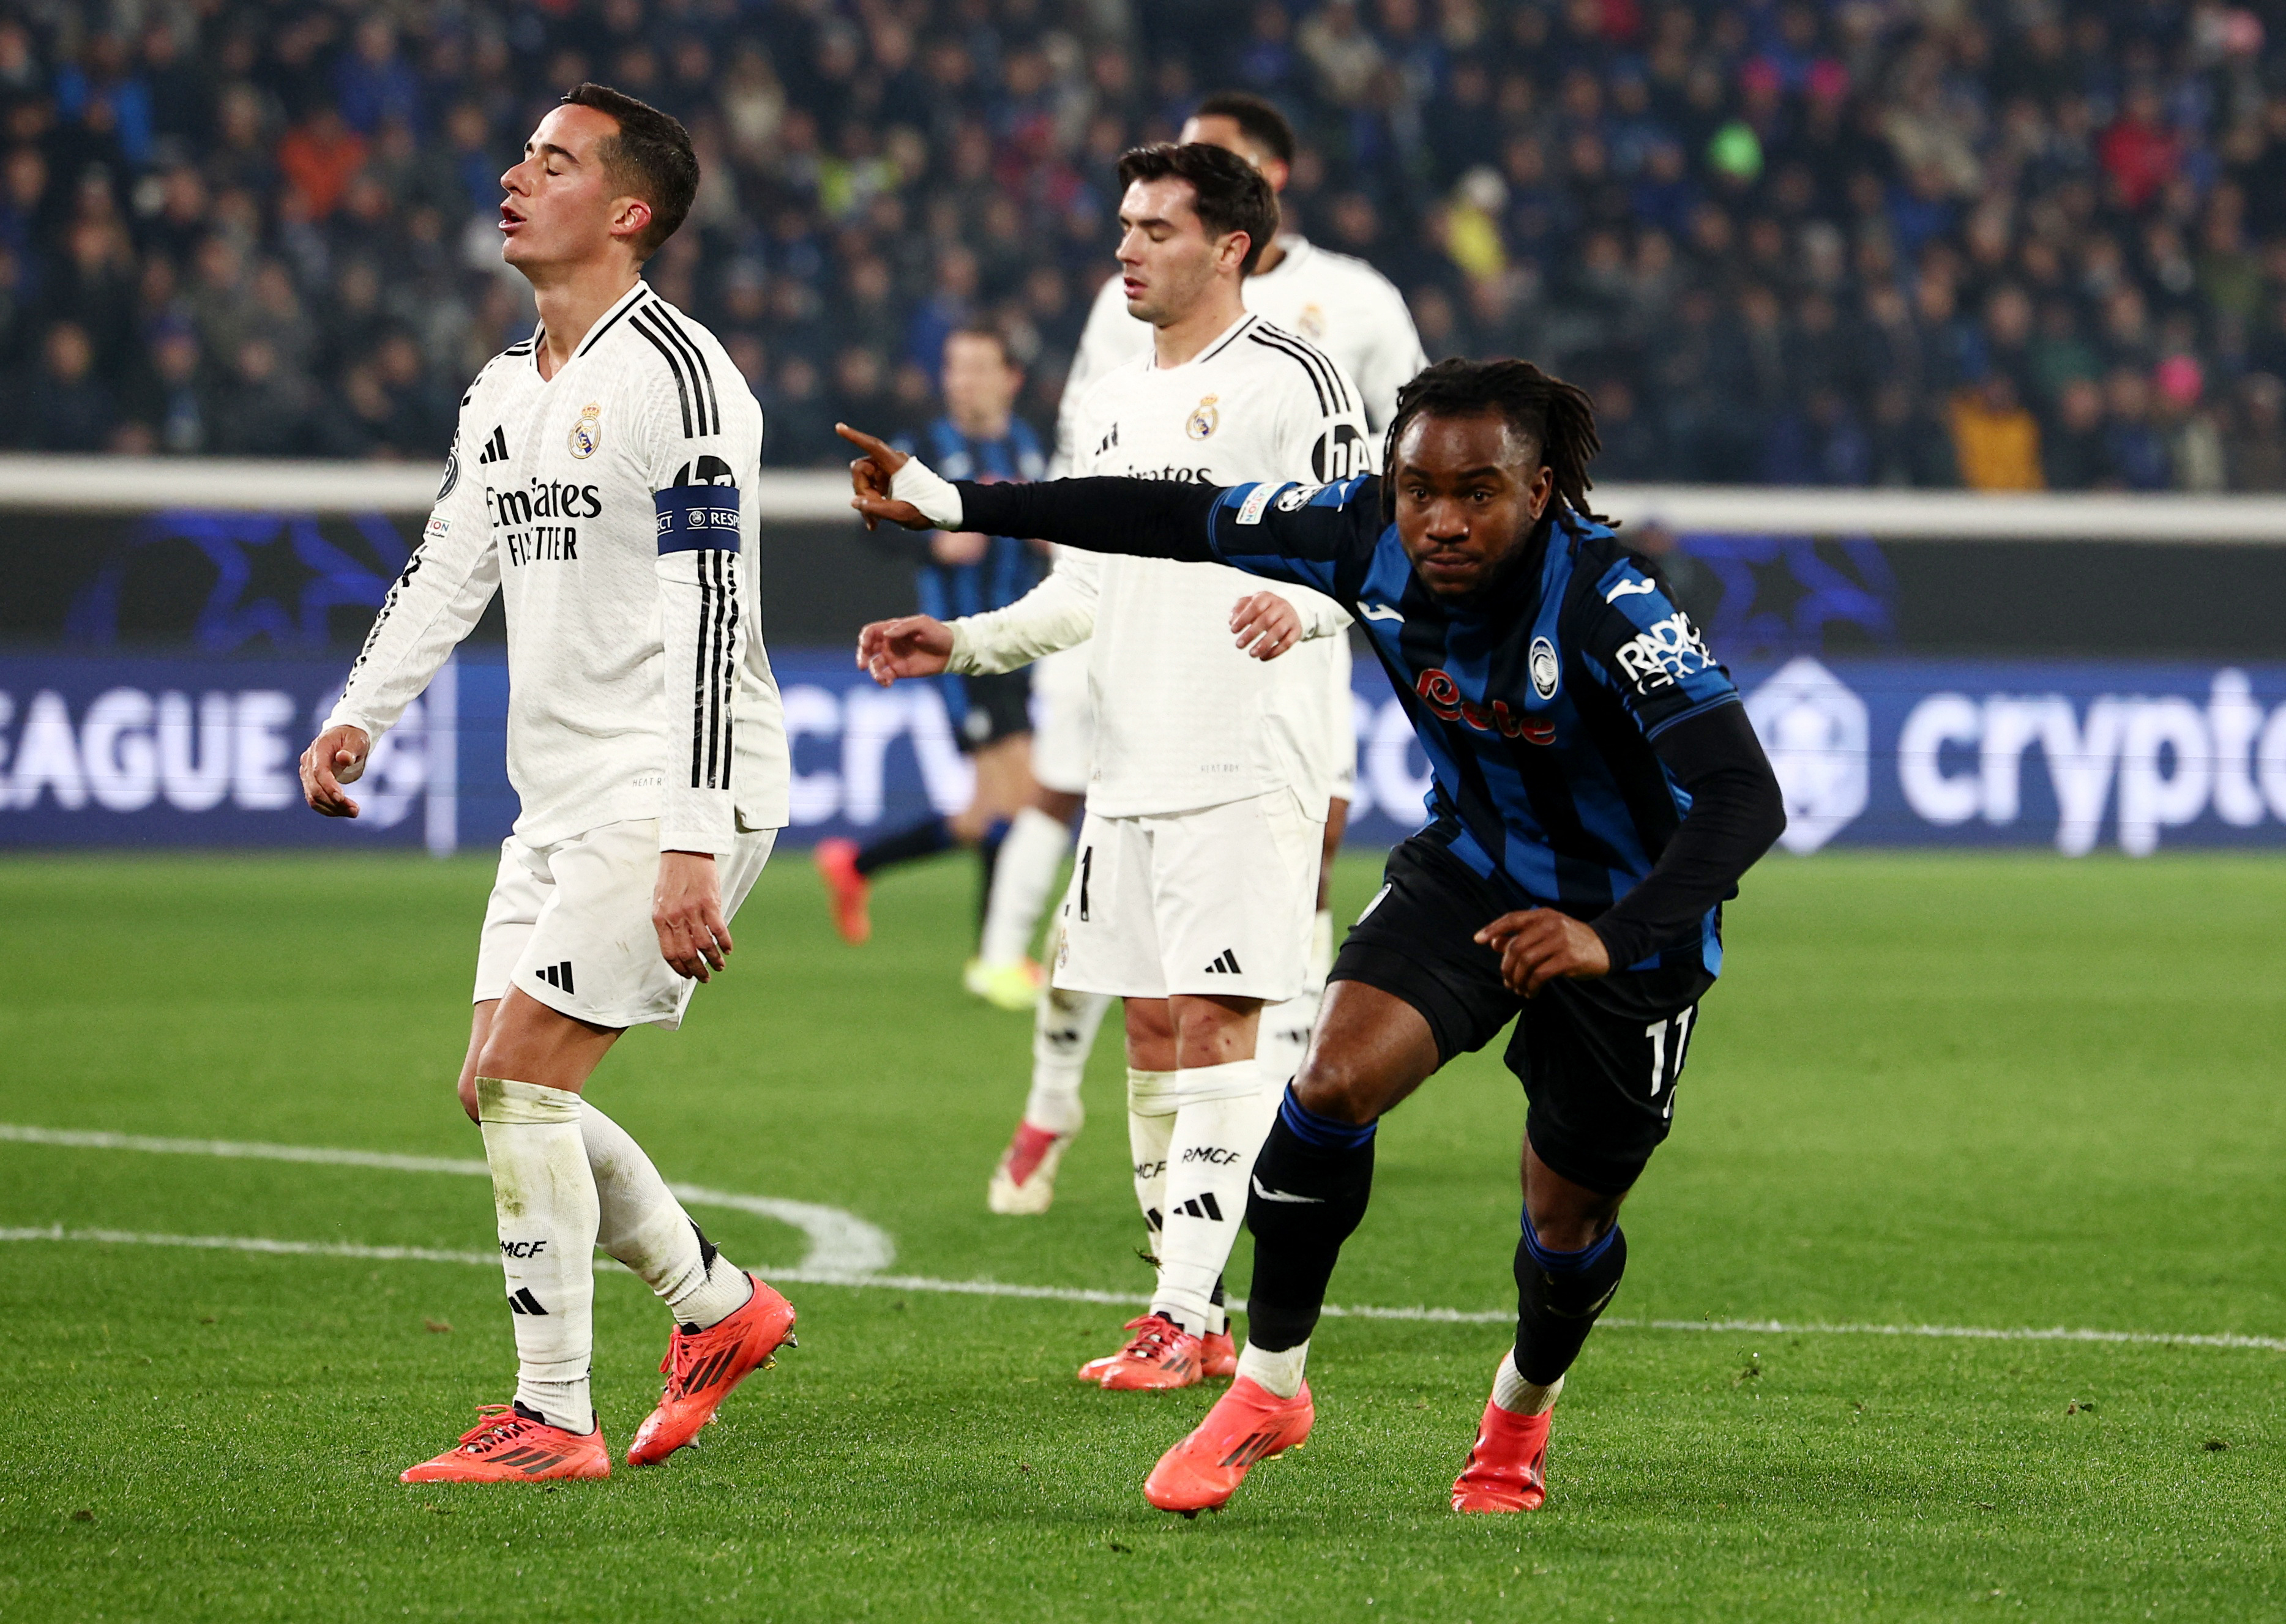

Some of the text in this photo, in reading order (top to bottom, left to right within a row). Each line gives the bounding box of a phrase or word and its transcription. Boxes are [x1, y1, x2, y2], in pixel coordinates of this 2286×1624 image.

[0, 686, 296, 813] AGUE
[1645, 1005, 1694, 1097] 11
[1181, 1146, 1241, 1165] RMCF
